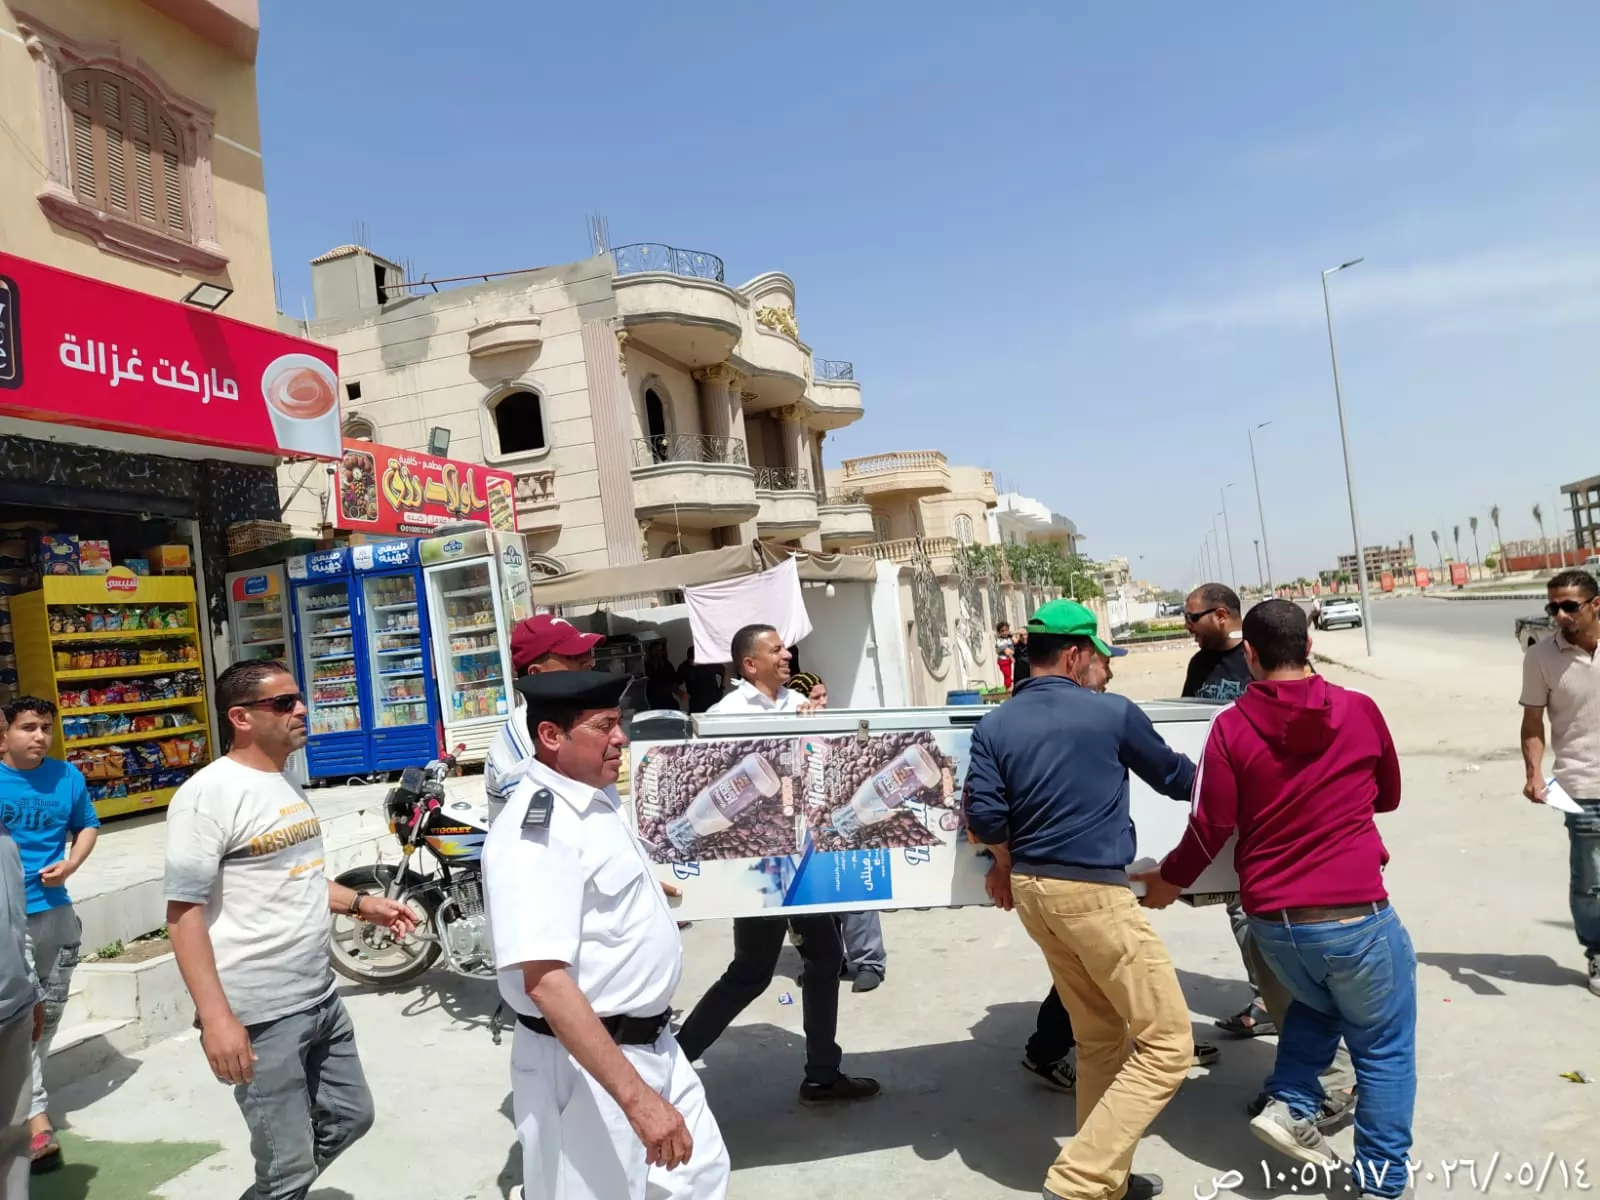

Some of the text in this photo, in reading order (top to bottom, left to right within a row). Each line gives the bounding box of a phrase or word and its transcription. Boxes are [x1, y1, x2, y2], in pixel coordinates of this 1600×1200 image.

[59, 333, 144, 387] غزالة
[152, 358, 239, 404] ماركت
[382, 458, 423, 512] رزق
[422, 461, 443, 471] مطعم
[807, 742, 827, 807] Healthy
